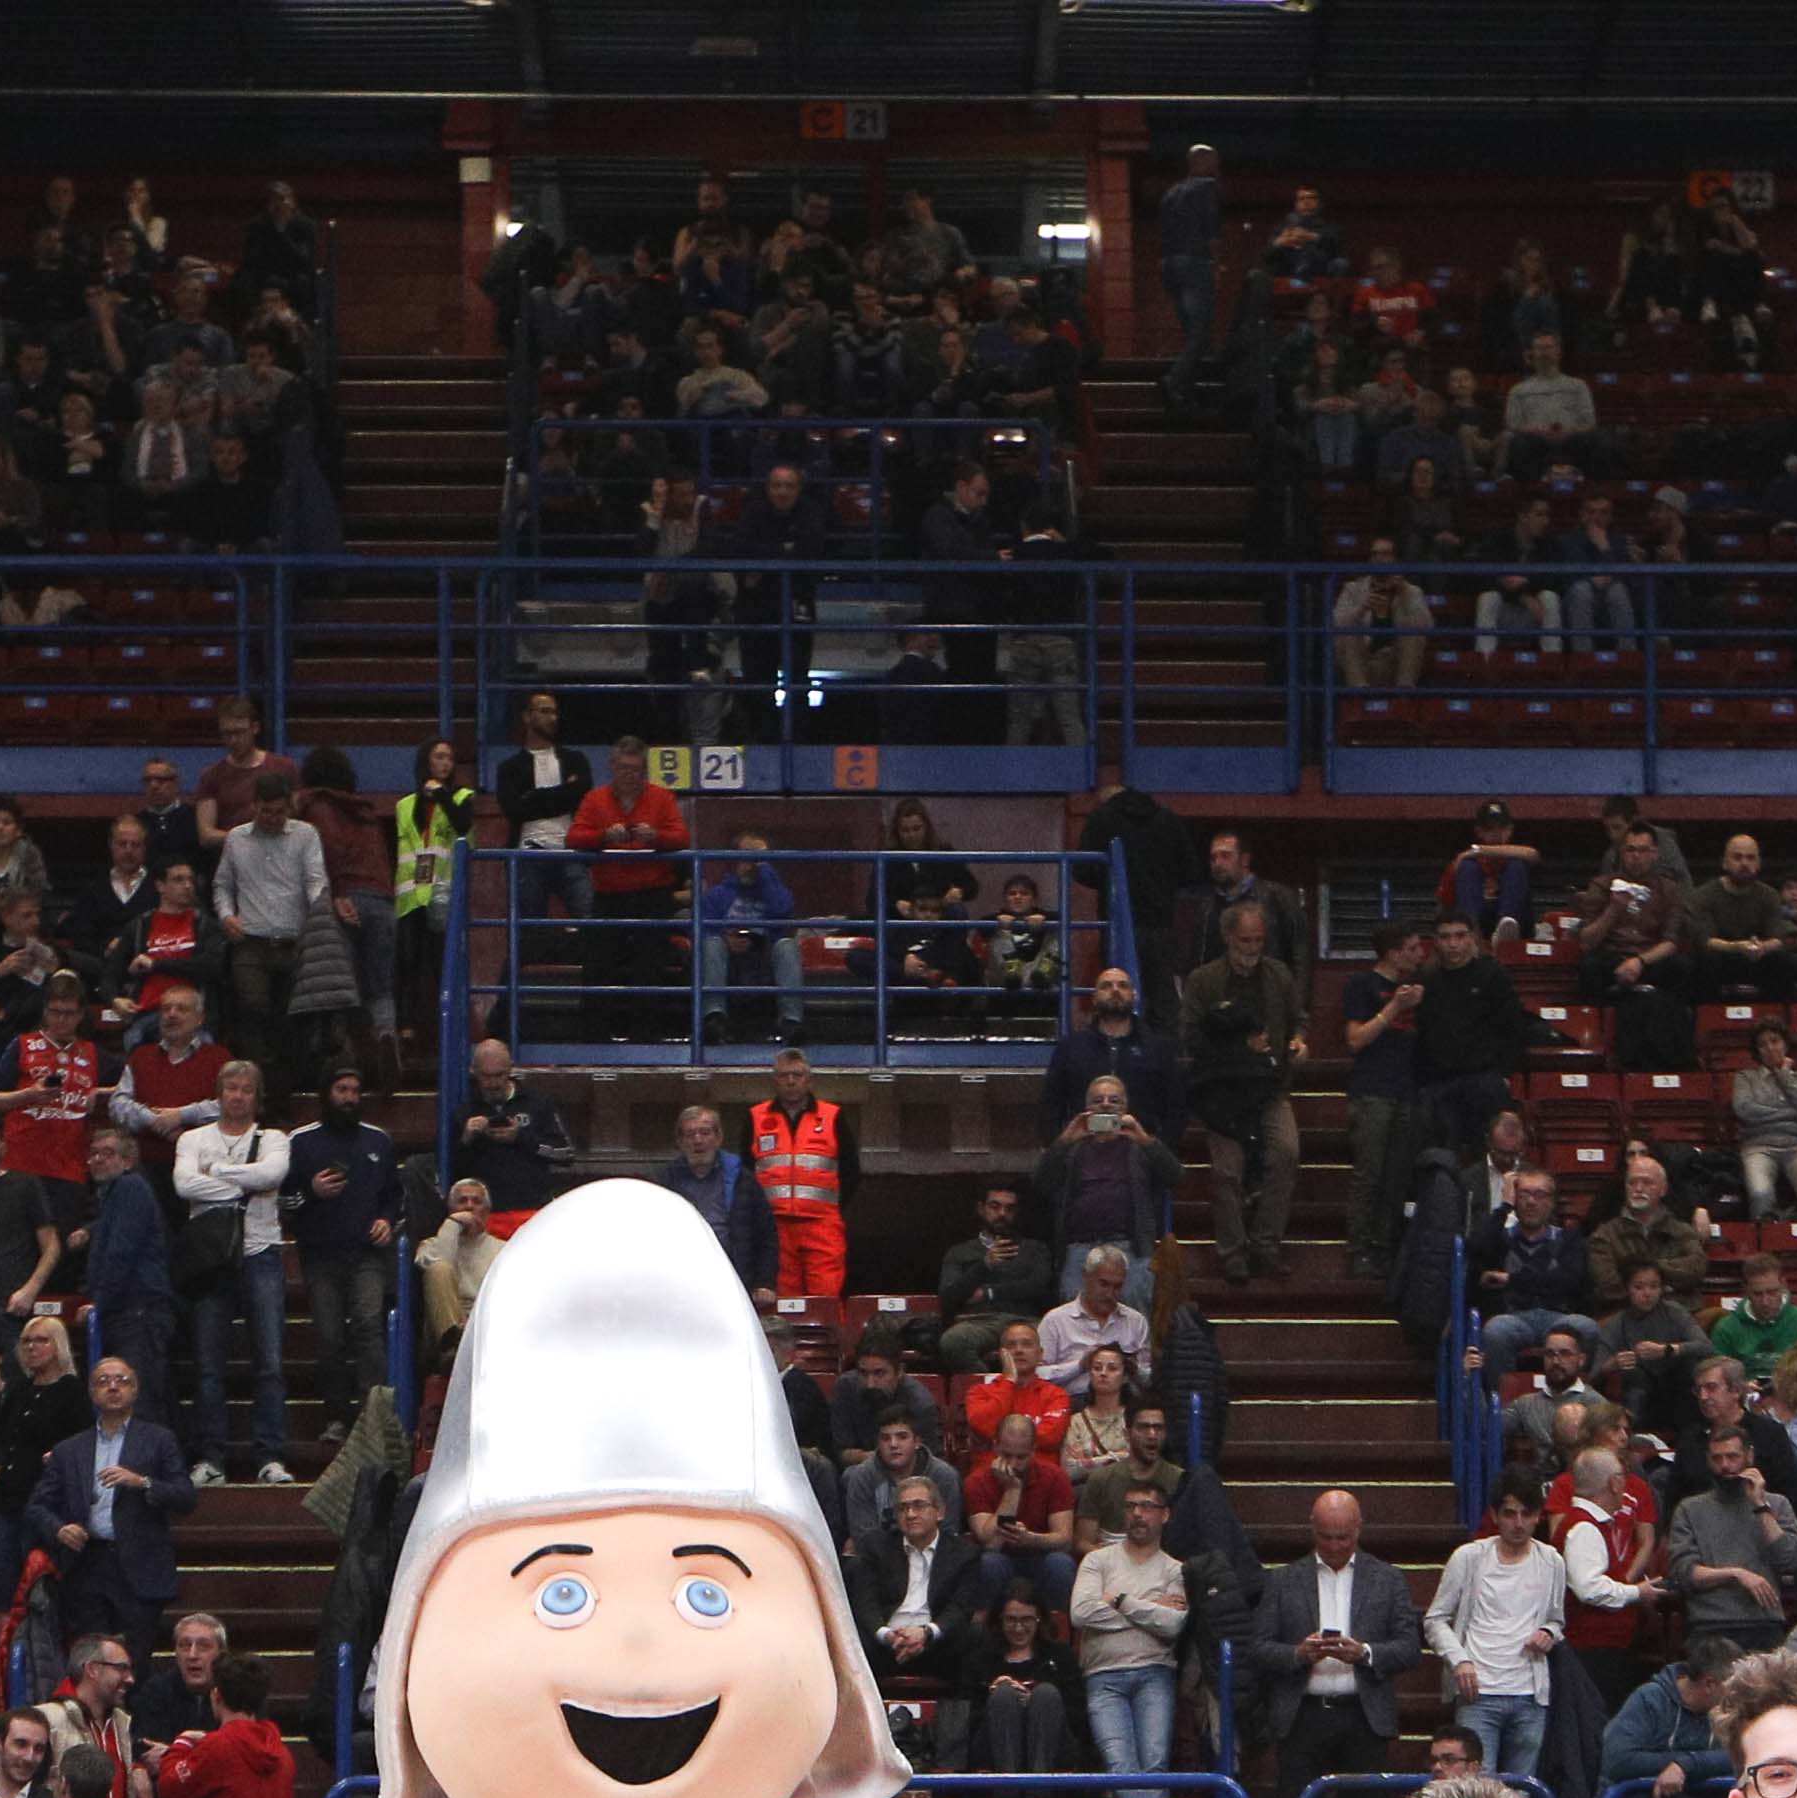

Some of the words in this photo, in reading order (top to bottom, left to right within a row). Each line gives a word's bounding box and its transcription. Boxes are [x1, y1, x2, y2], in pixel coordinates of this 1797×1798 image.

[662, 747, 679, 771] B
[704, 755, 739, 783] 21
[846, 765, 864, 786] C
